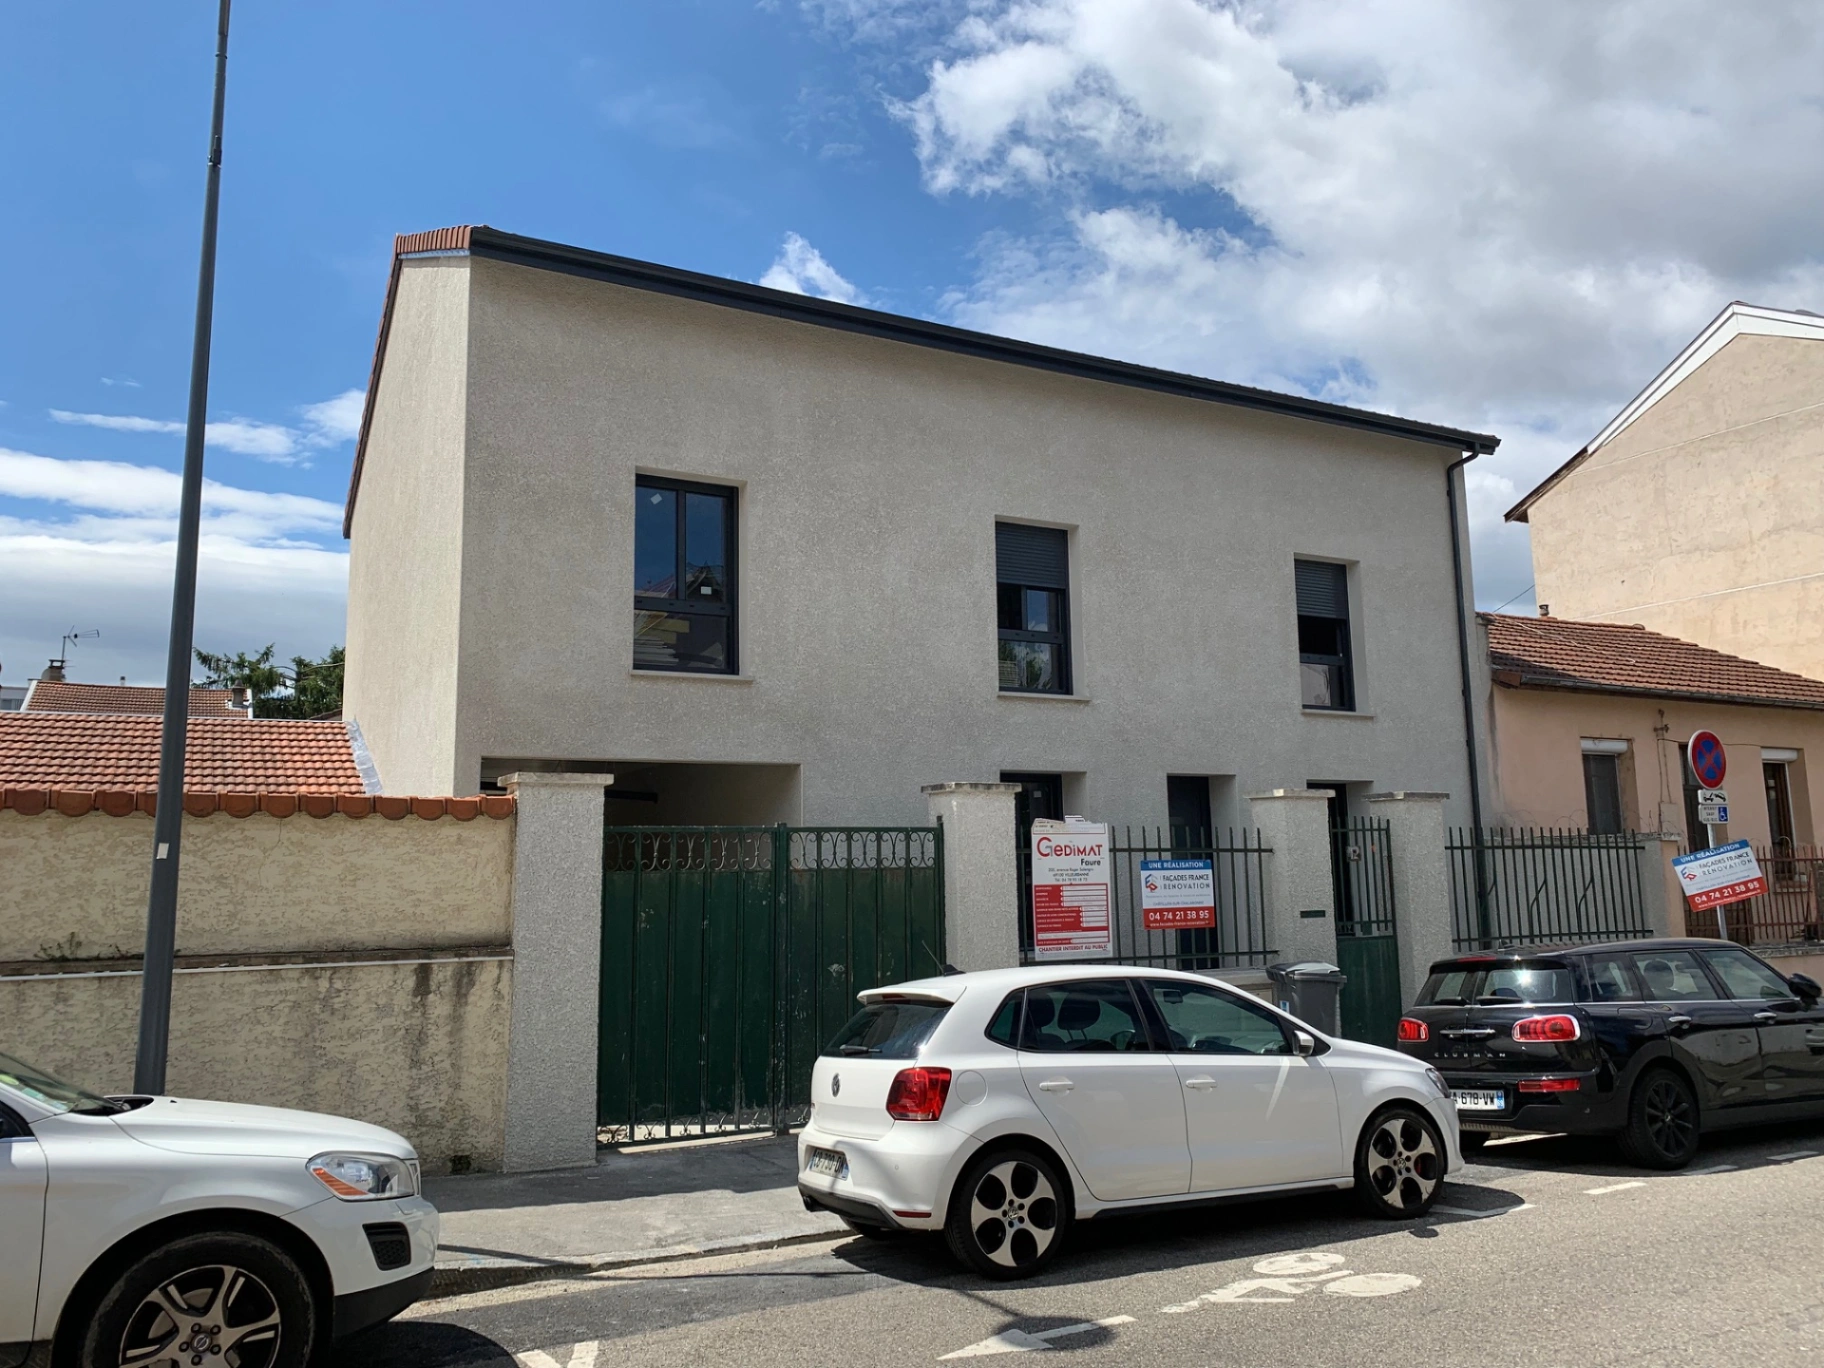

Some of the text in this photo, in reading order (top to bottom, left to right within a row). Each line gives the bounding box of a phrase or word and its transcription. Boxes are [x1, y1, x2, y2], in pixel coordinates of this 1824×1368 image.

[1726, 852, 1749, 862] FRANCE
[1695, 895, 1707, 903] 04
[1748, 881, 1759, 889] 95
[1149, 912, 1160, 920] 04
[1176, 911, 1184, 920] 21
[1186, 911, 1196, 919] 38
[1199, 910, 1209, 918] 95
